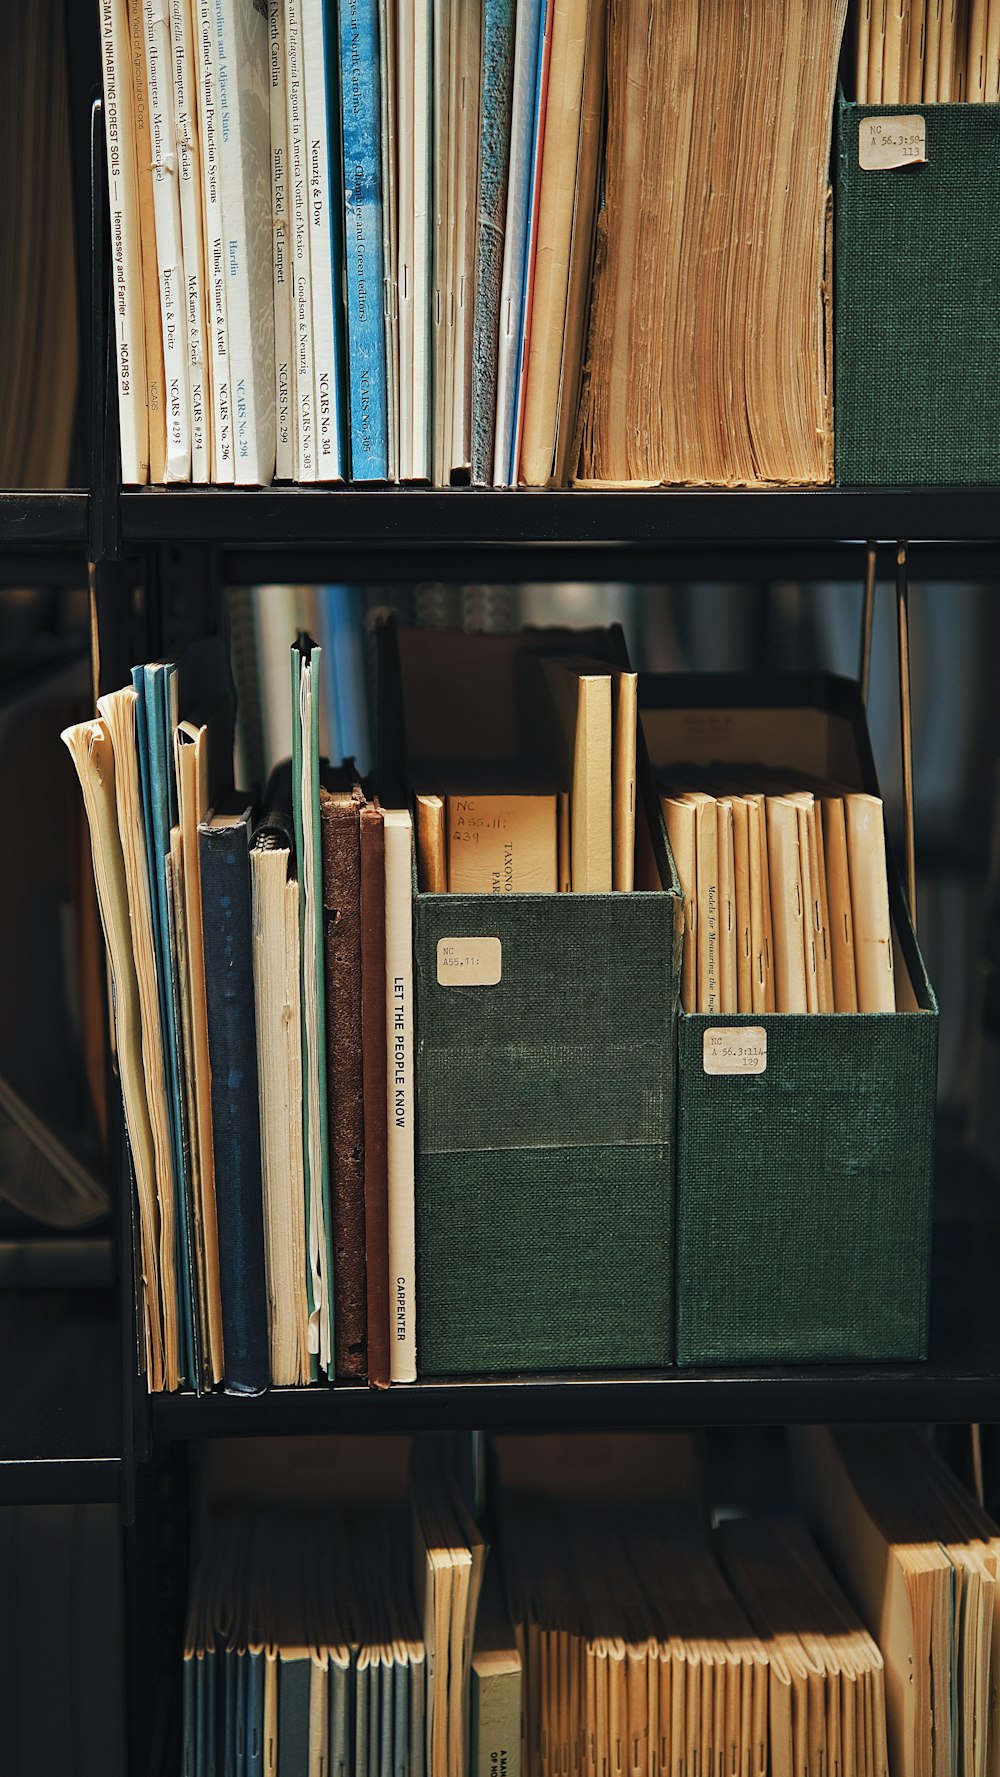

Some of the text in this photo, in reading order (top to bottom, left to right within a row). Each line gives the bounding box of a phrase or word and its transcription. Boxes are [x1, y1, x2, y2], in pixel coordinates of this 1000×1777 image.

[202, 8, 210, 18] in
[270, 8, 279, 39] North
[289, 7, 297, 25] and
[351, 19, 359, 30] in
[134, 41, 140, 50] of
[218, 40, 226, 60] and
[288, 28, 299, 78] Patagonia
[351, 33, 360, 65] North
[106, 41, 116, 100] INHABITING
[134, 52, 143, 100] Agricultural
[148, 46, 160, 108] (Homoptera:
[202, 20, 214, 106] Confined-Animal
[271, 42, 280, 87] Carolina
[218, 64, 228, 108] Adjacent
[290, 81, 300, 122] Ragonot
[352, 69, 361, 114] Carolina
[108, 103, 118, 141] FOREST
[136, 104, 144, 130] Crops
[222, 112, 230, 142] States
[293, 125, 301, 134] in
[870, 126, 882, 134] NC
[154, 114, 164, 181] Membraciae)
[206, 109, 217, 162] Production
[871, 137, 876, 145] A
[111, 145, 120, 176] SOILS
[274, 148, 283, 182] Smith,
[293, 138, 302, 177] America
[902, 148, 920, 156] 113
[208, 165, 218, 203] Systems
[295, 180, 303, 208] North
[275, 186, 284, 215] Eckel,
[296, 212, 304, 221] of
[114, 212, 123, 263] Hennessey
[174, 46, 185, 107] (Homoptera:
[188, 275, 198, 324] McKamey
[193, 384, 202, 422] NCARS
[297, 224, 305, 259] Mexico
[357, 222, 365, 241] and
[213, 238, 222, 276] Wilhoit,
[229, 240, 238, 276] Hardin
[275, 241, 284, 283] Lampert
[357, 244, 365, 276] Green
[117, 266, 126, 283] and
[164, 269, 174, 308] Dietrich
[118, 286, 126, 316] Farrier
[214, 278, 223, 313] Stinner
[298, 277, 306, 320] Goodson
[311, 140, 331, 455] Neunzig & Dow NCARS No. 304
[358, 280, 367, 322] (editors)
[167, 312, 174, 320] &
[300, 323, 307, 331] &
[167, 325, 176, 349] Deitz
[217, 328, 226, 355] Axtell
[120, 344, 130, 378] NCARS
[299, 334, 308, 374] Neunzig
[122, 381, 130, 396] 291
[150, 381, 158, 411] NCARS
[170, 379, 180, 416] NCARS
[236, 379, 246, 418] NCARS
[279, 363, 288, 402] NCARS
[361, 371, 370, 411] NCARS
[219, 383, 228, 420] NCARS
[280, 407, 288, 423] No.
[302, 394, 310, 431] NCARS
[173, 421, 181, 444] #293
[221, 426, 229, 441] No.
[240, 440, 248, 457] 298
[280, 427, 288, 443] 299
[302, 435, 311, 451] No.
[222, 444, 230, 460] 296
[456, 801, 474, 811] NC
[492, 872, 501, 893] PAR
[504, 842, 513, 892] TAXONO
[443, 958, 479, 966] A55.11:
[708, 932, 716, 976] Measuring
[394, 978, 405, 1128] LET THE PEOPLE KNOW
[743, 1058, 758, 1066] 129
[397, 1277, 405, 1341] CARPENTER
[490, 1752, 498, 1763] OF
